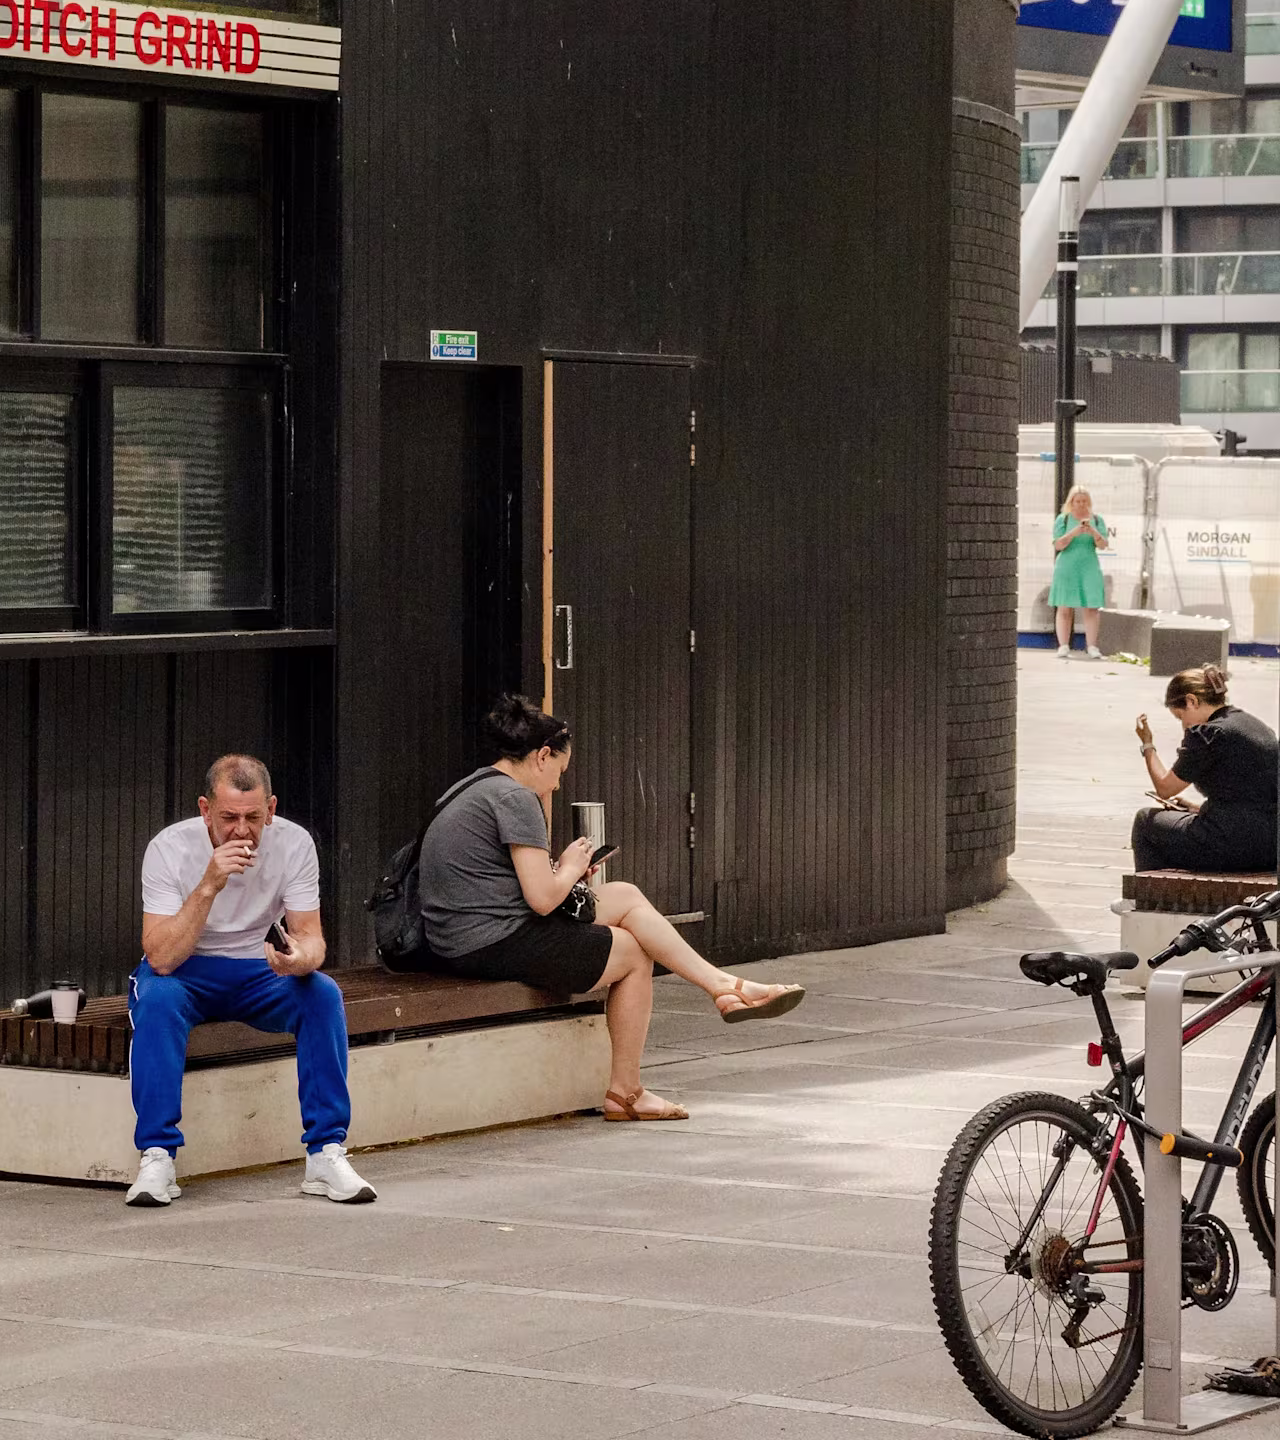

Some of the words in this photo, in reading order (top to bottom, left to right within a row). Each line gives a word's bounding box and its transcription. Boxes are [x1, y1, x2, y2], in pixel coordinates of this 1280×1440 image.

[133, 11, 262, 74] GRIND
[445, 334, 458, 345] Fire
[458, 335, 470, 346] exit
[442, 345, 457, 357] Keep
[458, 346, 472, 356] clear
[1187, 532, 1251, 544] MORGAN
[1187, 545, 1248, 558] SINDALL
